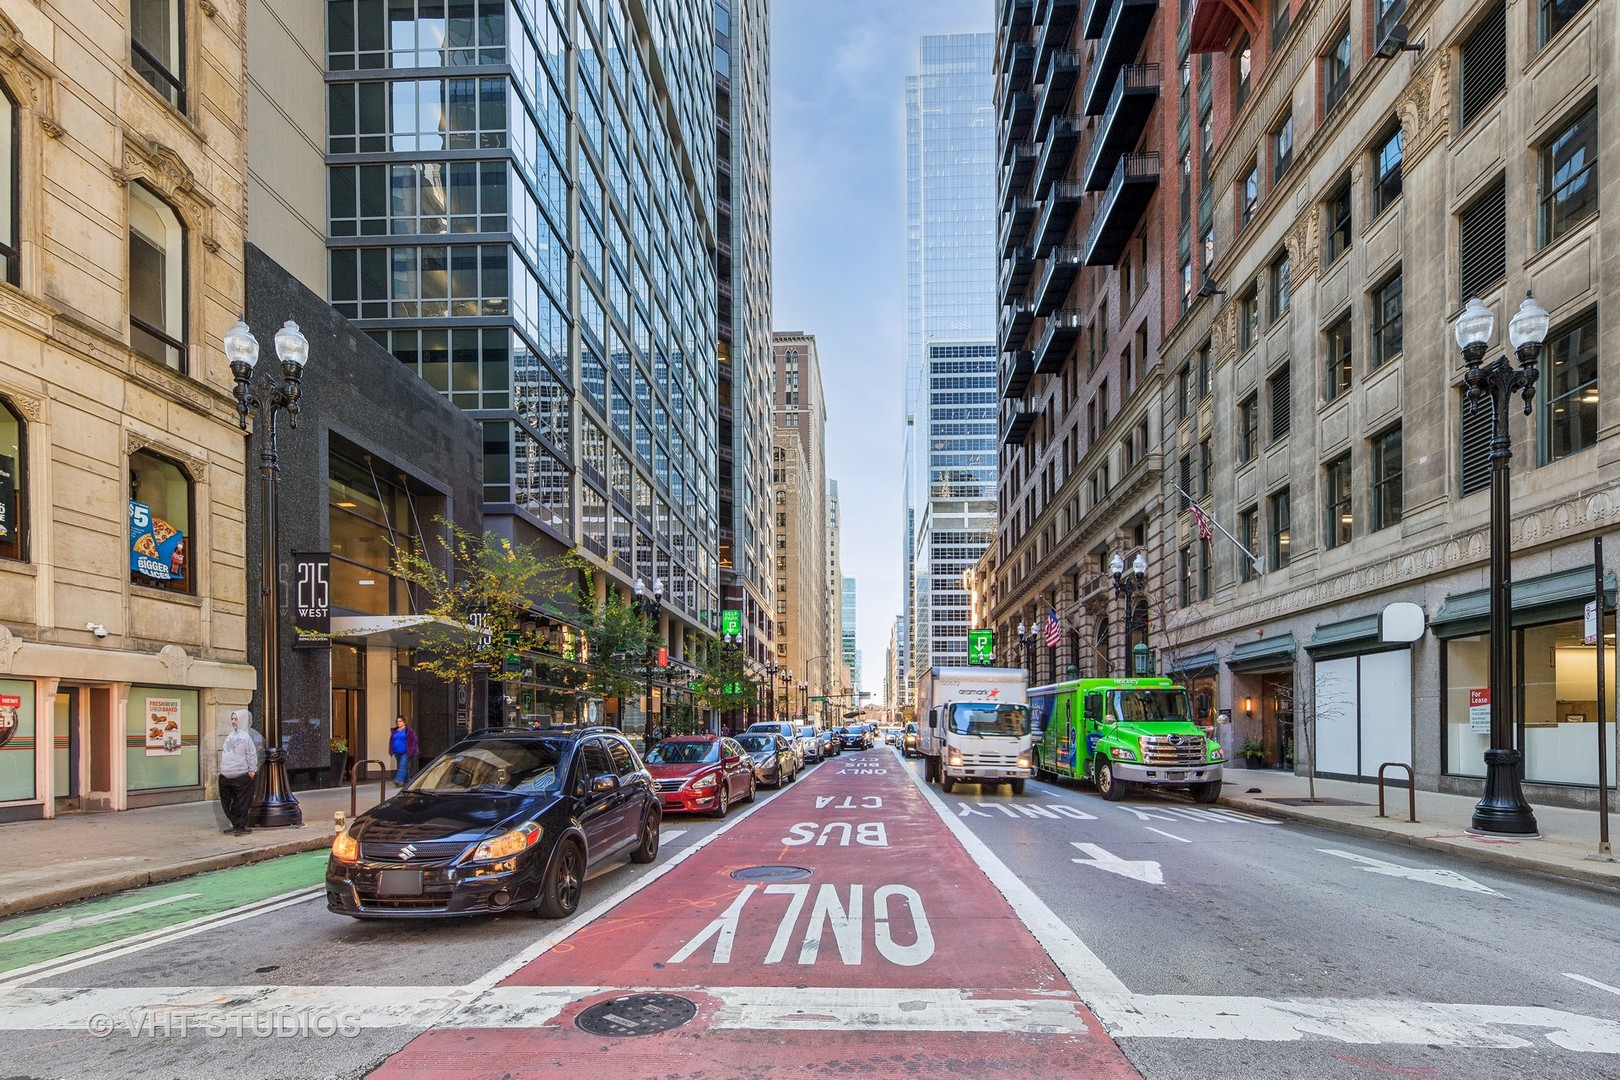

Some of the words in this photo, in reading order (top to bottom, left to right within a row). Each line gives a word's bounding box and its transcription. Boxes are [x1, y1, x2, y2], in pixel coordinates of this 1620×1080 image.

[129, 504, 149, 527] $5
[138, 560, 169, 574] BIGGER
[298, 562, 329, 608] 215
[298, 608, 329, 618] WEST
[815, 796, 883, 809] CTA
[957, 802, 1099, 819] ONLY
[781, 821, 889, 847] BUS
[666, 883, 936, 967] ONLY
